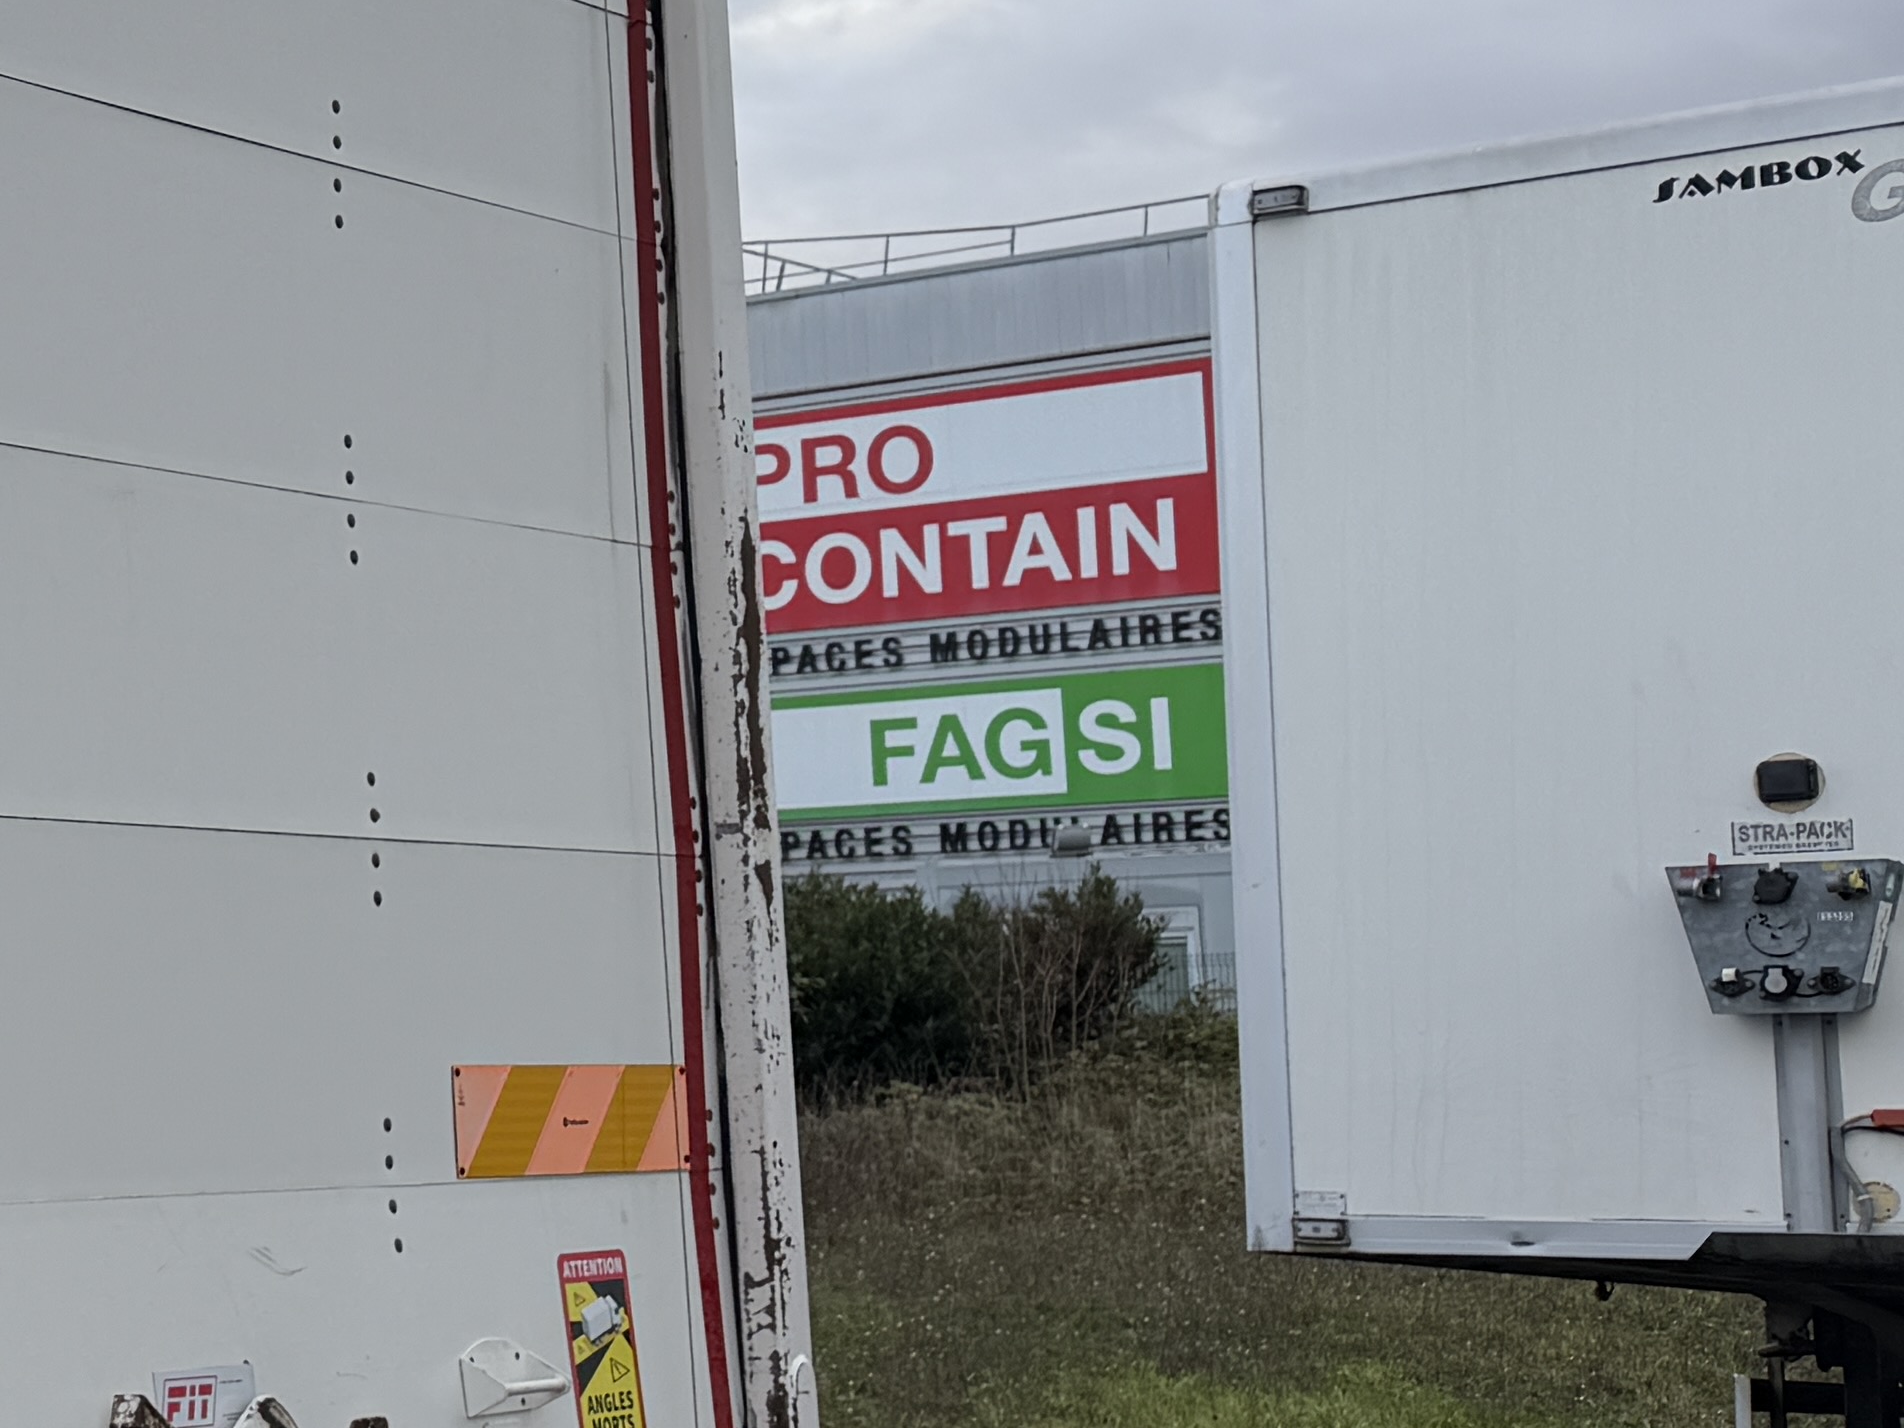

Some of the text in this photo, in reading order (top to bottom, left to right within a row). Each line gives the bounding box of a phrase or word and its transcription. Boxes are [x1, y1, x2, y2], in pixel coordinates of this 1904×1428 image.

[1652, 149, 1865, 203] SAMBOX
[760, 497, 1177, 611] CONTAIN
[930, 608, 1222, 663] MODULAIRES
[563, 1256, 623, 1278] ATTENTION
[588, 1390, 634, 1415] ANGLES
